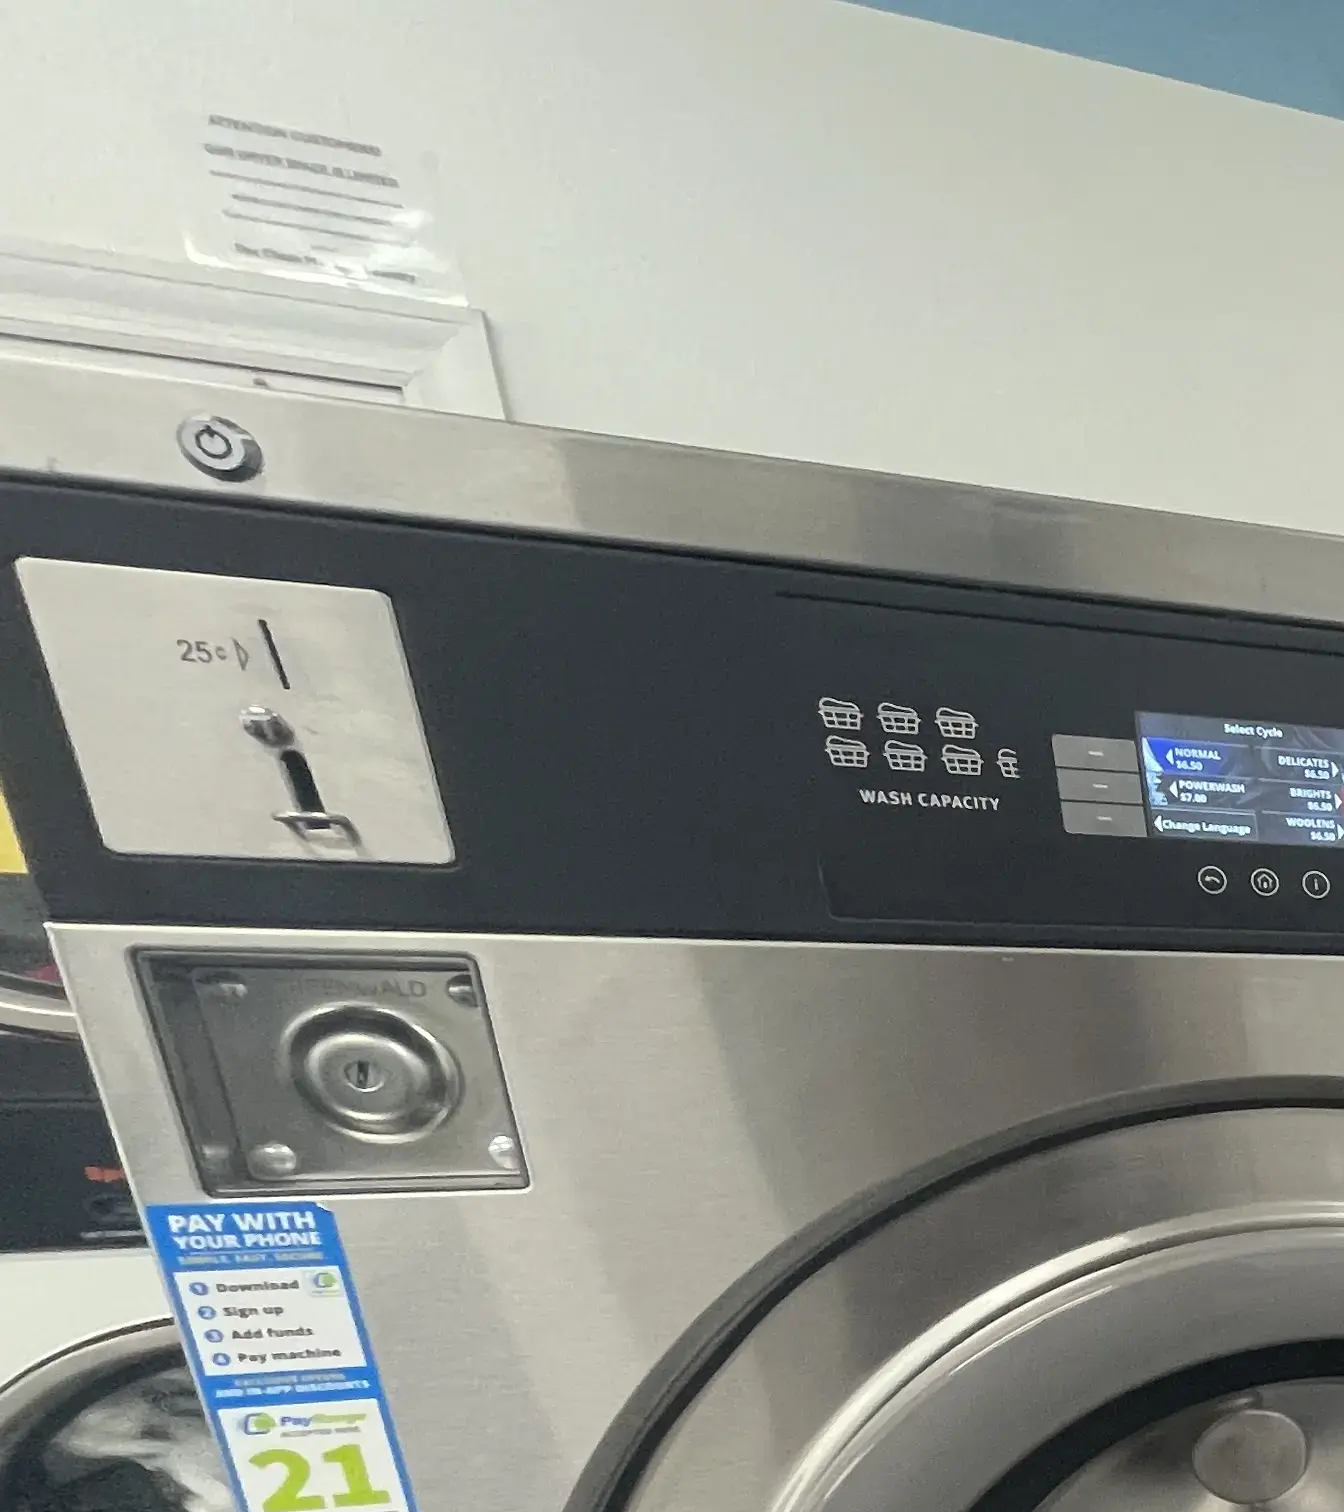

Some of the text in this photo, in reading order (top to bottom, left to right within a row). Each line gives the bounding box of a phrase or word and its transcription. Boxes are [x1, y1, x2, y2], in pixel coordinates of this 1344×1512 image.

[1223, 723, 1284, 739] Select Cycle
[1174, 747, 1221, 761] NORMAL
[1278, 755, 1330, 769] DELICATES
[1178, 779, 1245, 794] POWERWASH
[1289, 787, 1331, 800] BRIGHTS
[858, 788, 1000, 811] WASH CAPACITY
[1162, 818, 1251, 836] Change Language
[1286, 817, 1335, 829] WOOLENS
[167, 1210, 316, 1233] PAY WITH
[172, 1231, 323, 1250] YOUR PHONE
[216, 1280, 300, 1292] Download
[222, 1306, 284, 1318] Sign up
[232, 1326, 314, 1339] Add funds
[237, 1349, 341, 1364] Pay machine
